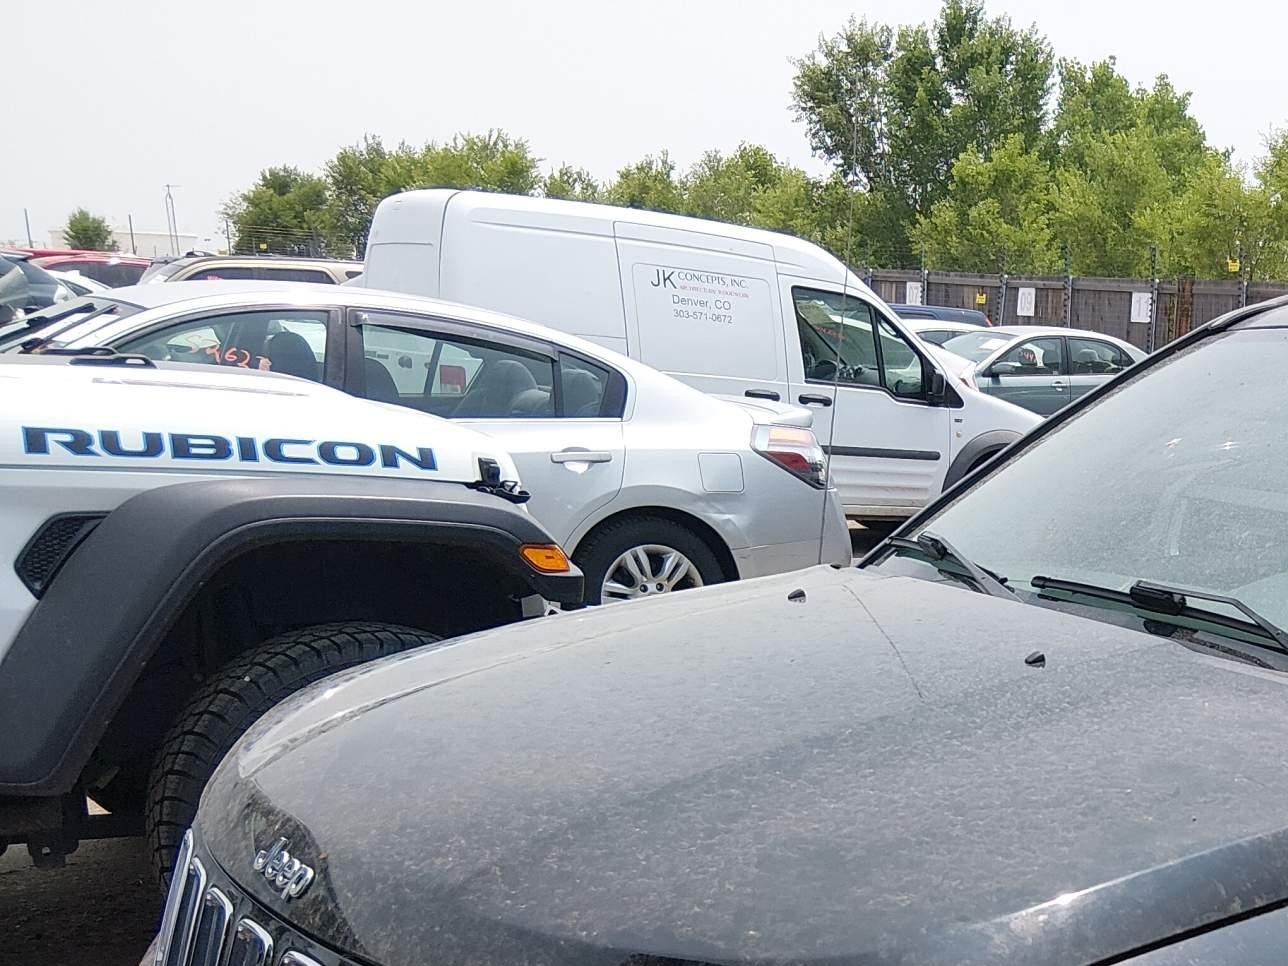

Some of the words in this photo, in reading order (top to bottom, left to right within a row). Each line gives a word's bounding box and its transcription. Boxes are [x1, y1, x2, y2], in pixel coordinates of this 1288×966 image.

[650, 268, 677, 290] JK
[677, 271, 728, 287] CONCEPTS,
[672, 294, 711, 309] Denver,
[714, 299, 731, 310] CO
[673, 308, 733, 324] 303-571-0672
[21, 425, 439, 471] RUBICON
[253, 836, 315, 900] Jeep
